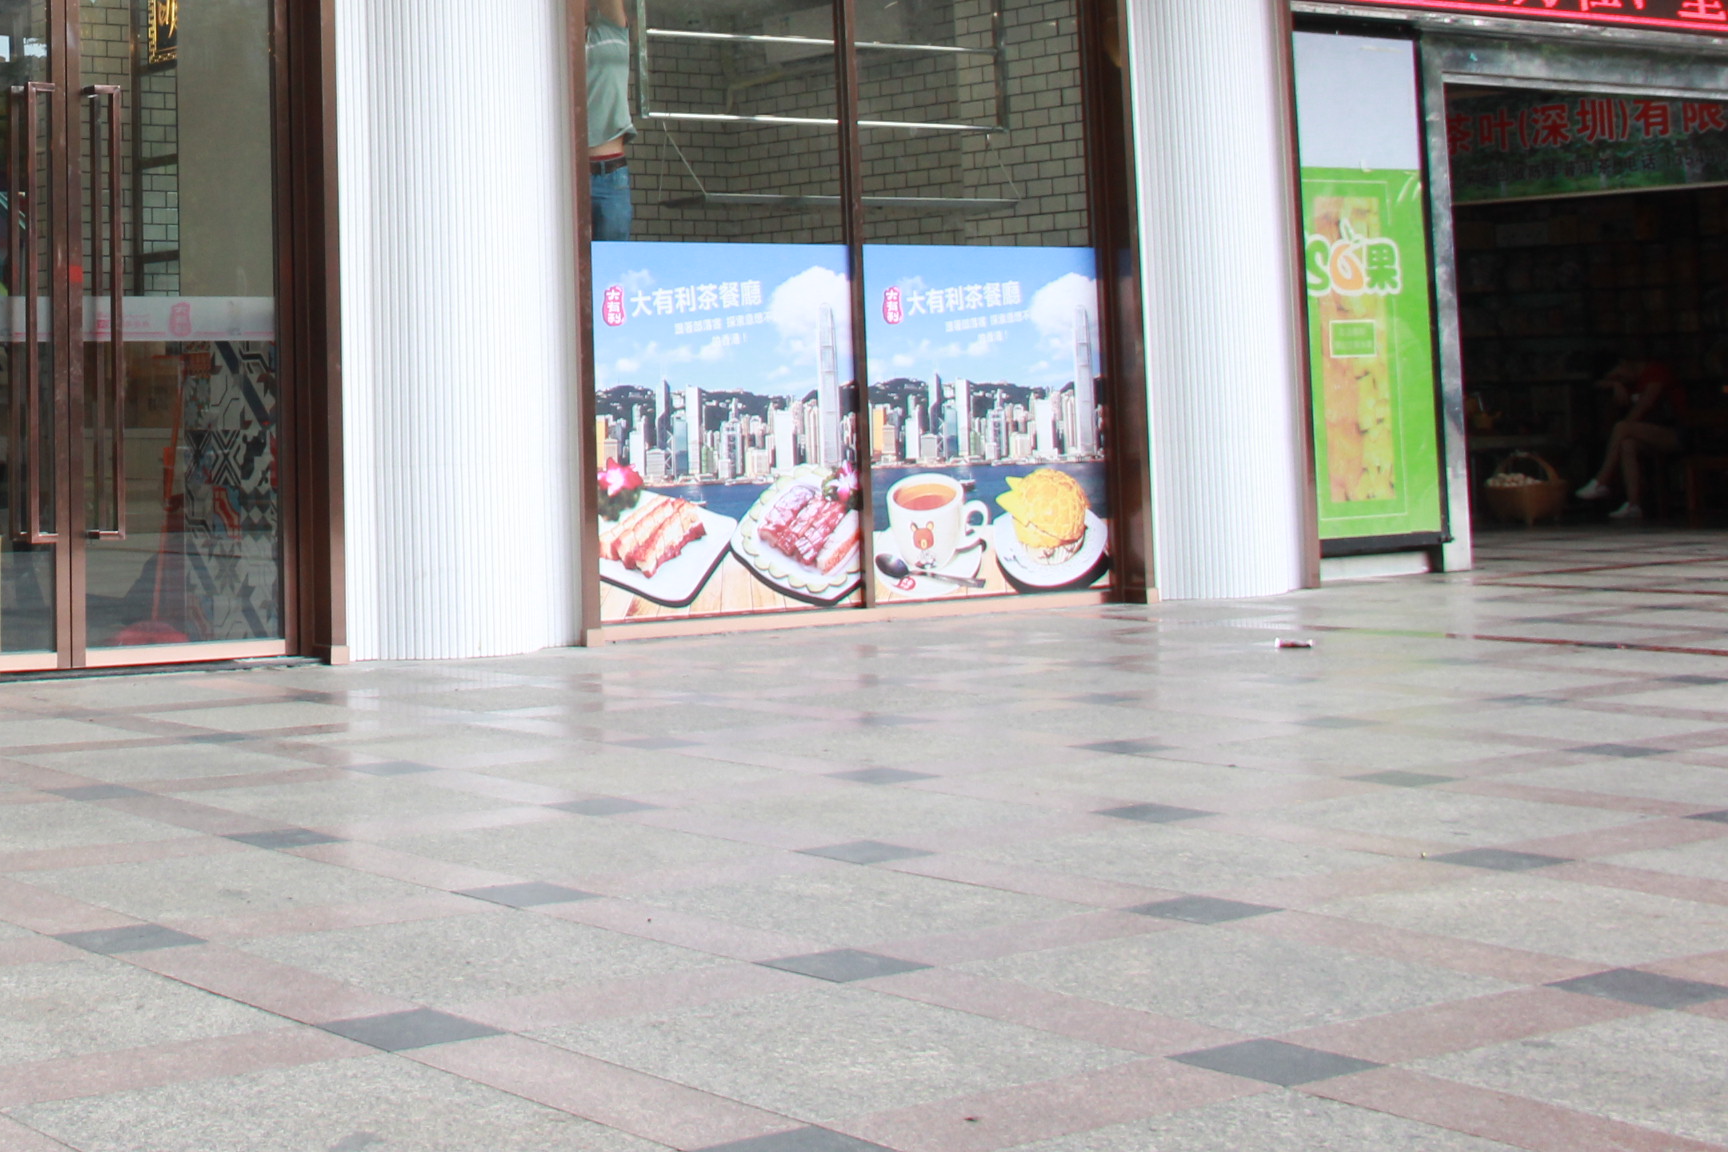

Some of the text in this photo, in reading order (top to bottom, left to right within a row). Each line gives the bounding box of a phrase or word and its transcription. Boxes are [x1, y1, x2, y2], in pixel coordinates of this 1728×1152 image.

[629, 279, 763, 318] 大有利茶餐廳
[906, 279, 1022, 317] 大有利茶餐廳
